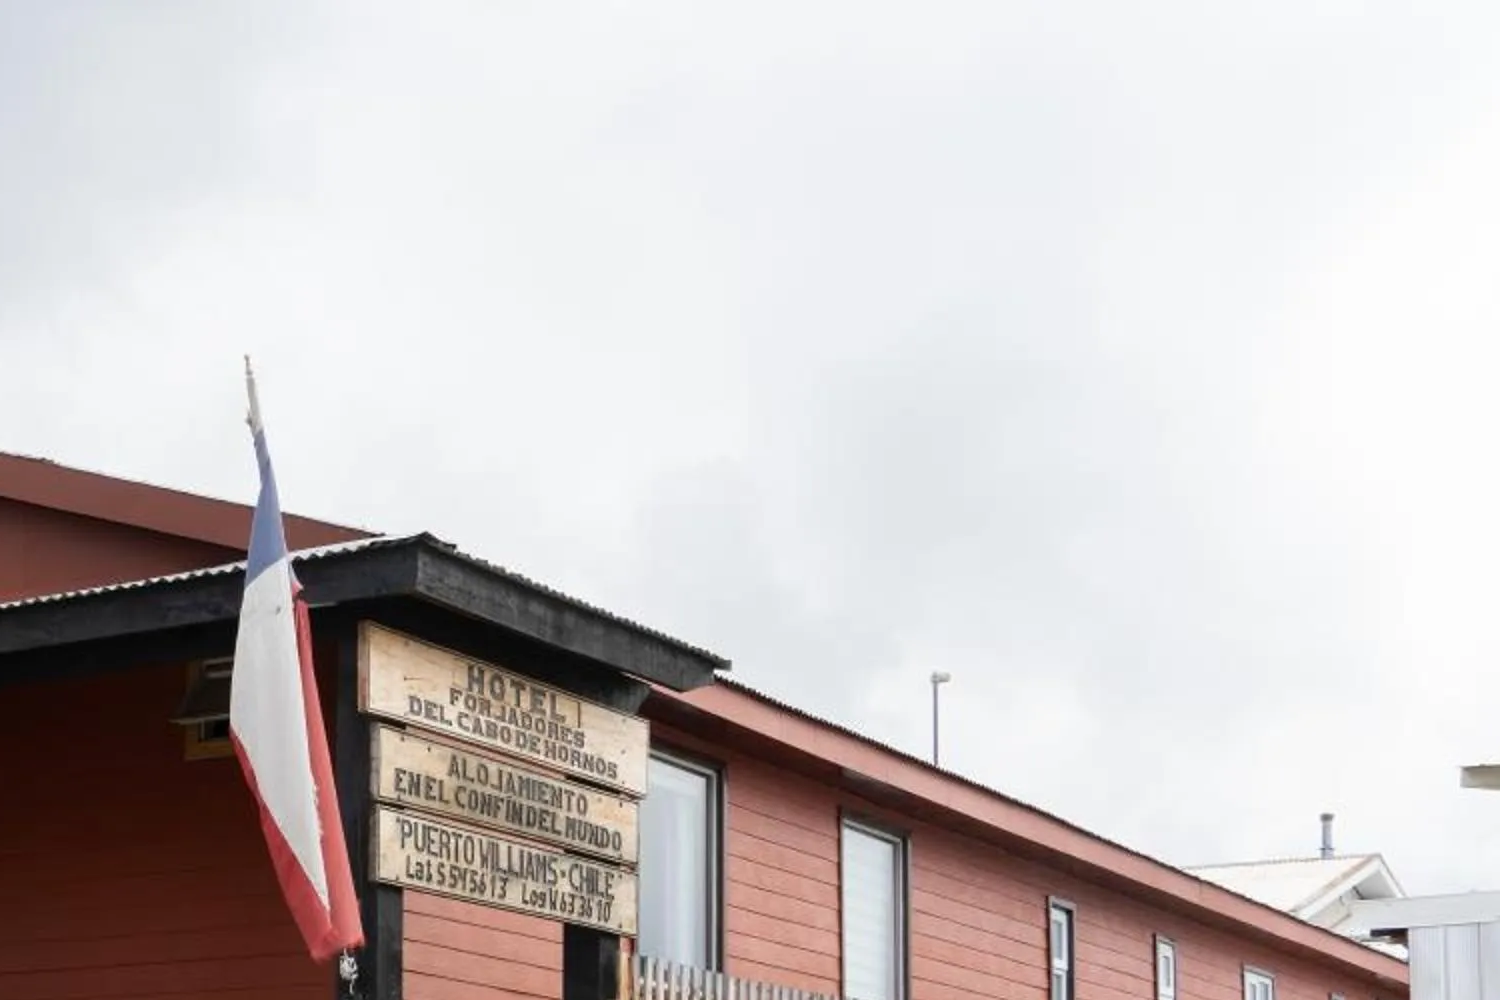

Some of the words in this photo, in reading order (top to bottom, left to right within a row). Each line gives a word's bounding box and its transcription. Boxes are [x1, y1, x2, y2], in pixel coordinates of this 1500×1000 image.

[449, 687, 585, 748] FORJADORES
[466, 664, 566, 723] HOTEL
[407, 695, 453, 726] DEL
[457, 711, 512, 744] CABO
[516, 729, 541, 755] DE
[544, 739, 618, 779] HORNOS
[447, 754, 588, 816] ALOJAMIENTO
[526, 805, 561, 836] DEL
[565, 815, 622, 850] MUNDO
[401, 818, 475, 865] PUERTO
[568, 863, 615, 901] CHILE
[405, 855, 432, 882] Lat
